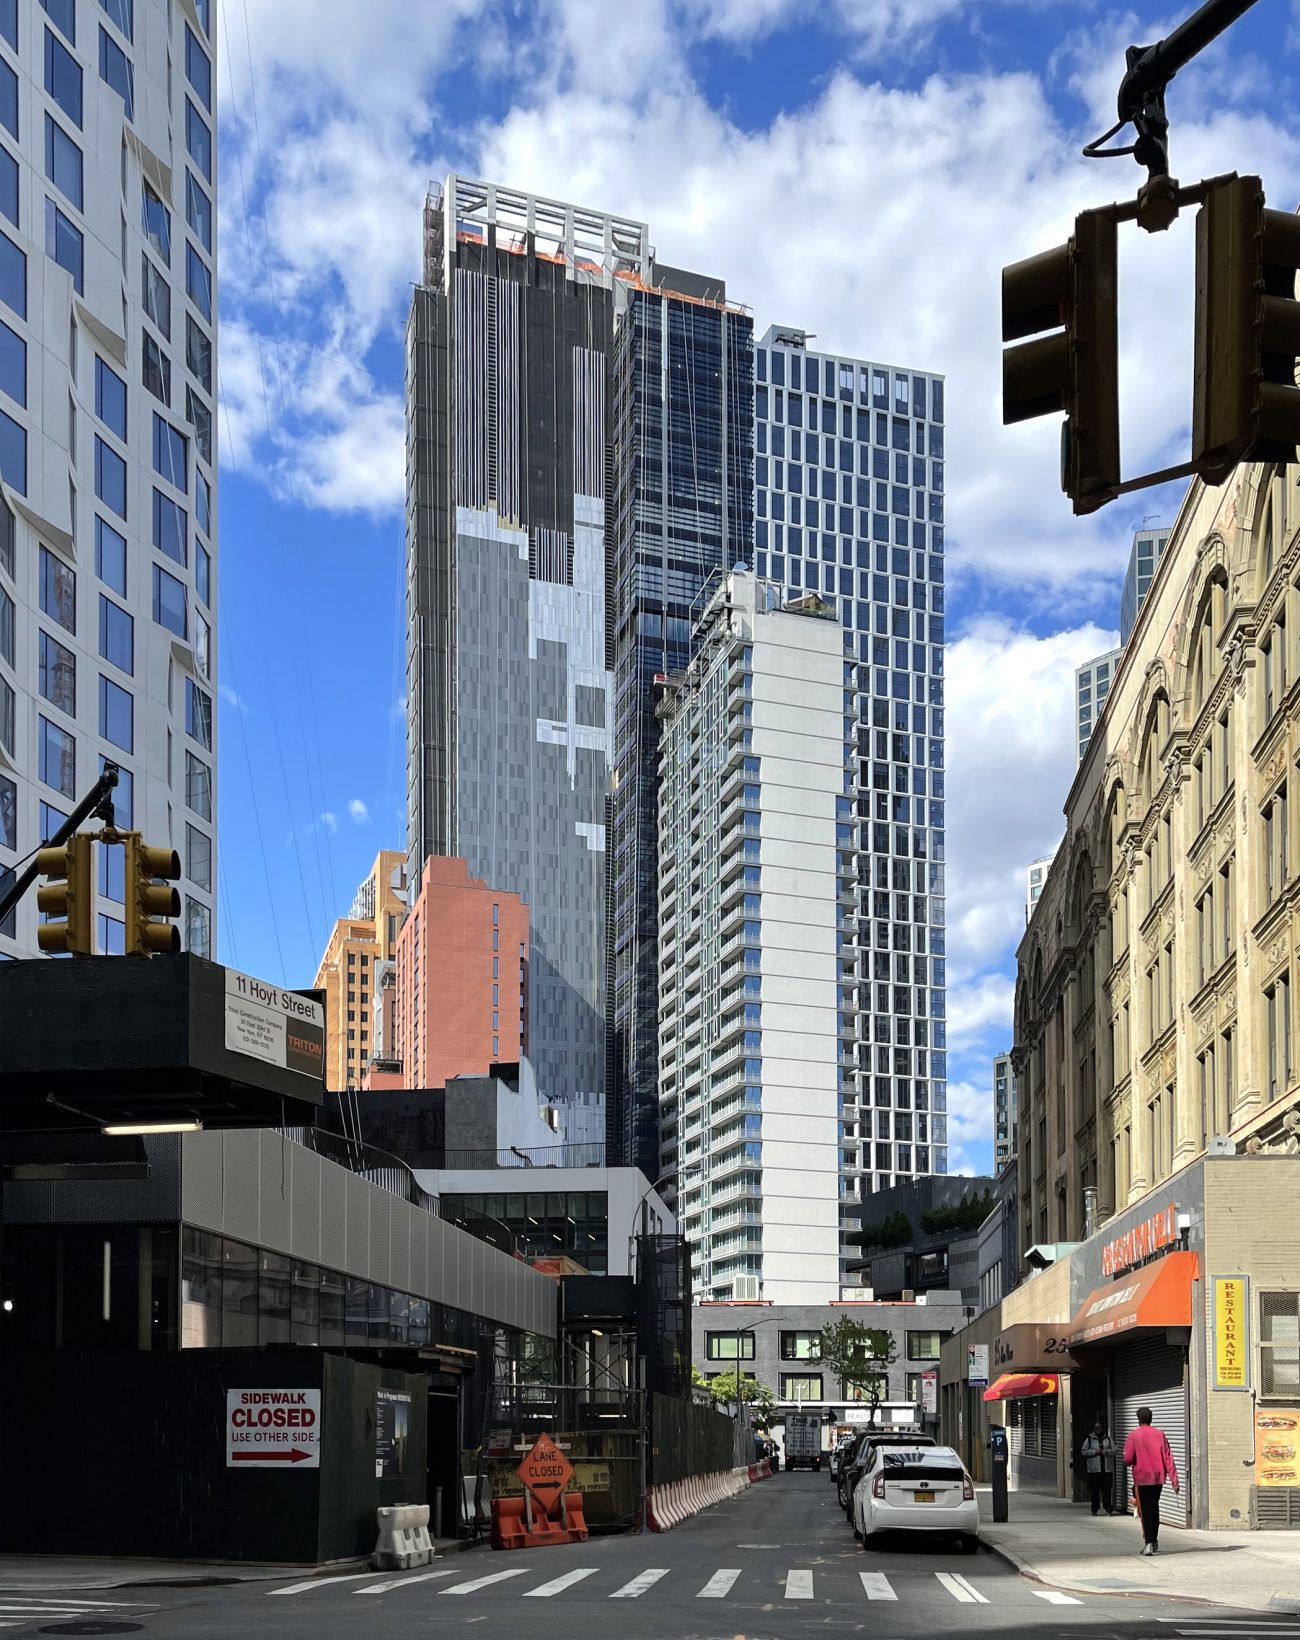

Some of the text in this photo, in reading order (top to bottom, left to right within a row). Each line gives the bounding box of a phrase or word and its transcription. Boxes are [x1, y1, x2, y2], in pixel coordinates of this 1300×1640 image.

[236, 975, 316, 1020] 11 Hoyt Street
[287, 1034, 322, 1056] TRITON
[1224, 1282, 1236, 1366] RESTAURANT
[241, 1393, 306, 1404] SIDEWALK
[231, 1408, 316, 1428] CLOSED
[232, 1432, 315, 1442] USE OTHER SIDE
[997, 1437, 1003, 1447] P
[533, 1451, 558, 1462] LANE
[528, 1465, 564, 1477] CLOSED
